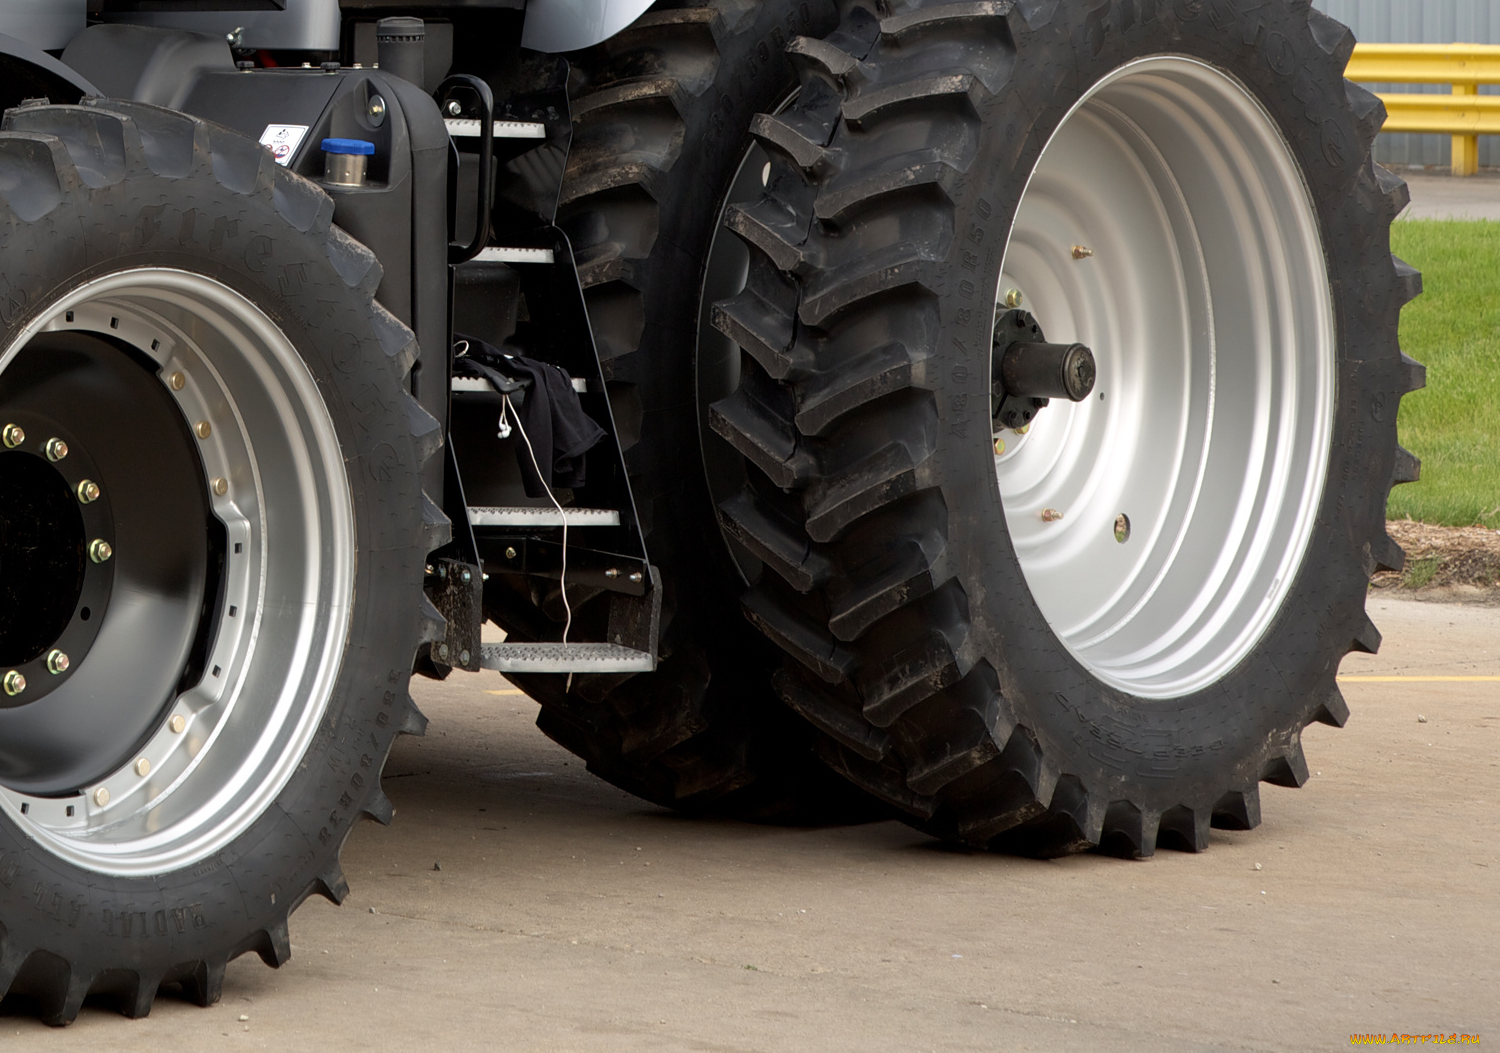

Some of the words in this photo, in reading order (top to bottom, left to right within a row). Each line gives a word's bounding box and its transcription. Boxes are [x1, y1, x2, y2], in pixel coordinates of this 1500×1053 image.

[950, 197, 993, 439] 480/80R50
[33, 880, 88, 929] ALL
[101, 901, 210, 939] RADIAL
